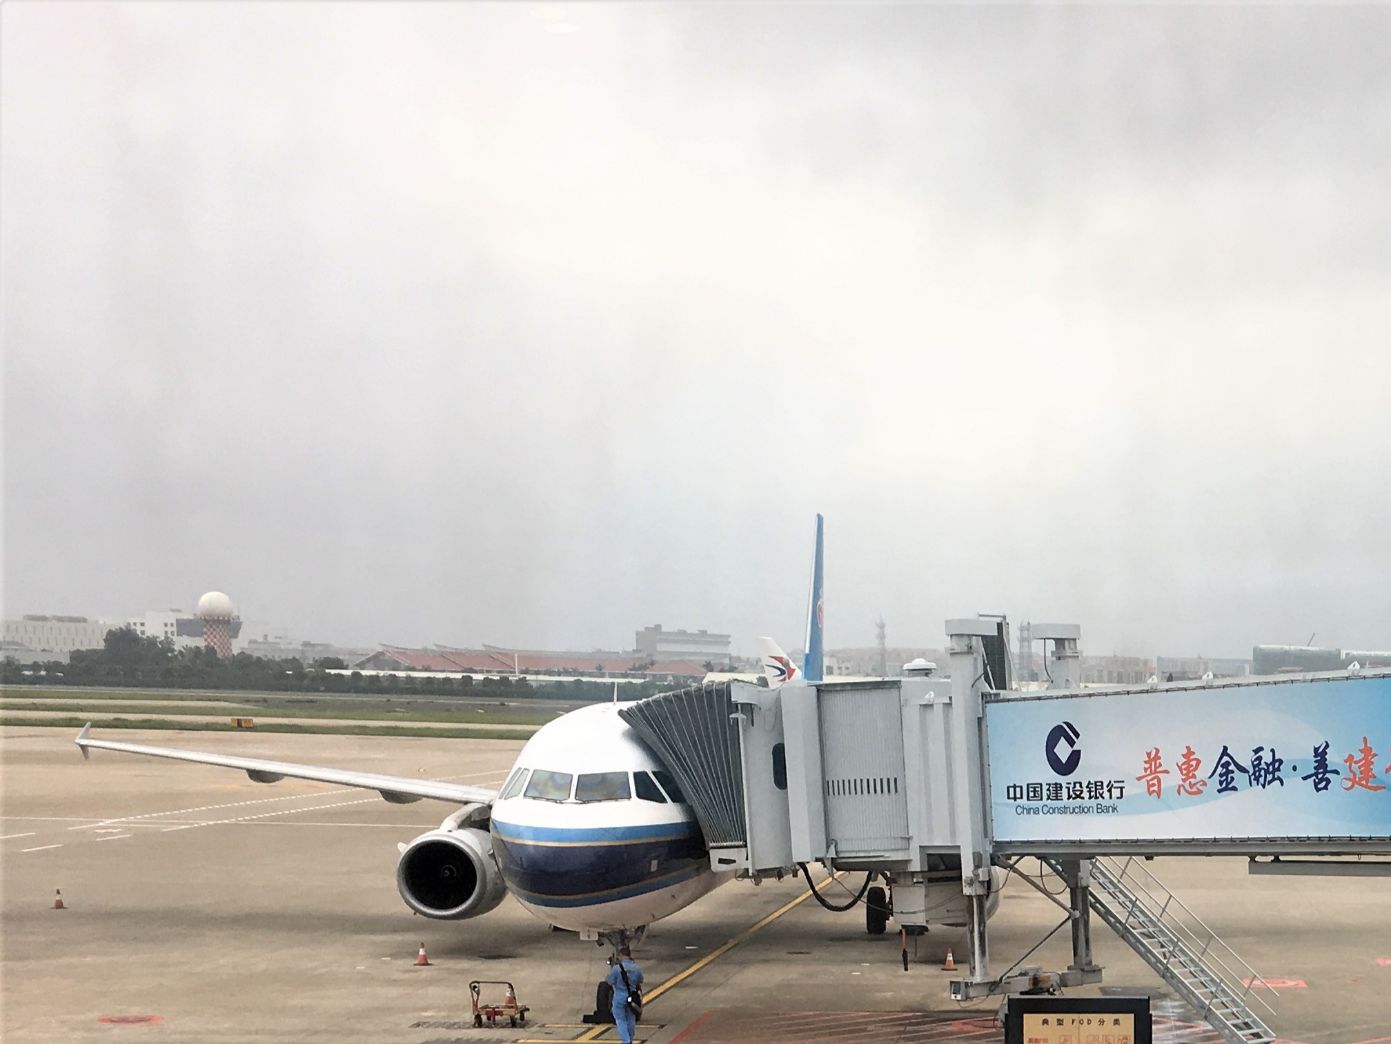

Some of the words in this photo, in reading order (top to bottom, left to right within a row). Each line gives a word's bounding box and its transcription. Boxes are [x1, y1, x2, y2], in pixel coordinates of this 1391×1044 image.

[1006, 780, 1126, 802] 中国建设银行
[1015, 804, 1040, 815] China
[1041, 804, 1094, 815] Construction
[1096, 803, 1119, 814] Bank
